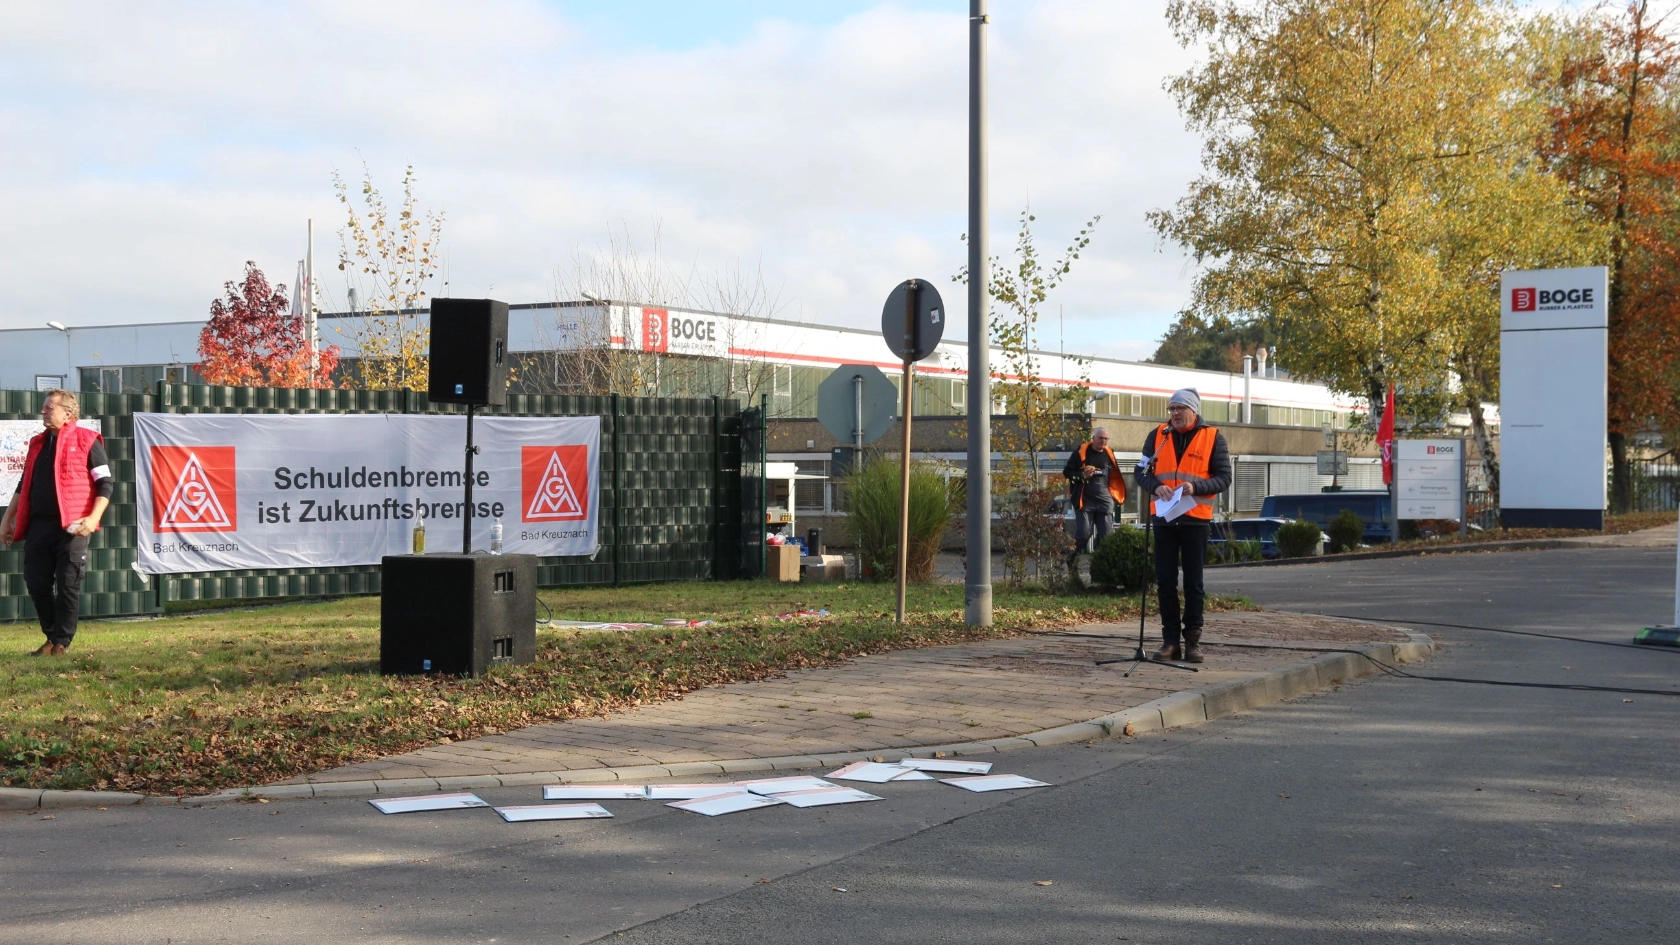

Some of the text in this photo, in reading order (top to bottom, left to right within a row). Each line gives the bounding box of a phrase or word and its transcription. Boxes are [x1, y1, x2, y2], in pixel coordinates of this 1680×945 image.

[1539, 289, 1593, 304] BOGE
[556, 323, 577, 331] HALLE
[671, 318, 716, 341] BOGE
[258, 498, 505, 524] ist Zukunftsbremse
[521, 529, 588, 541] Bad Kreuznach
[153, 541, 239, 554] Bad Kreuznach
